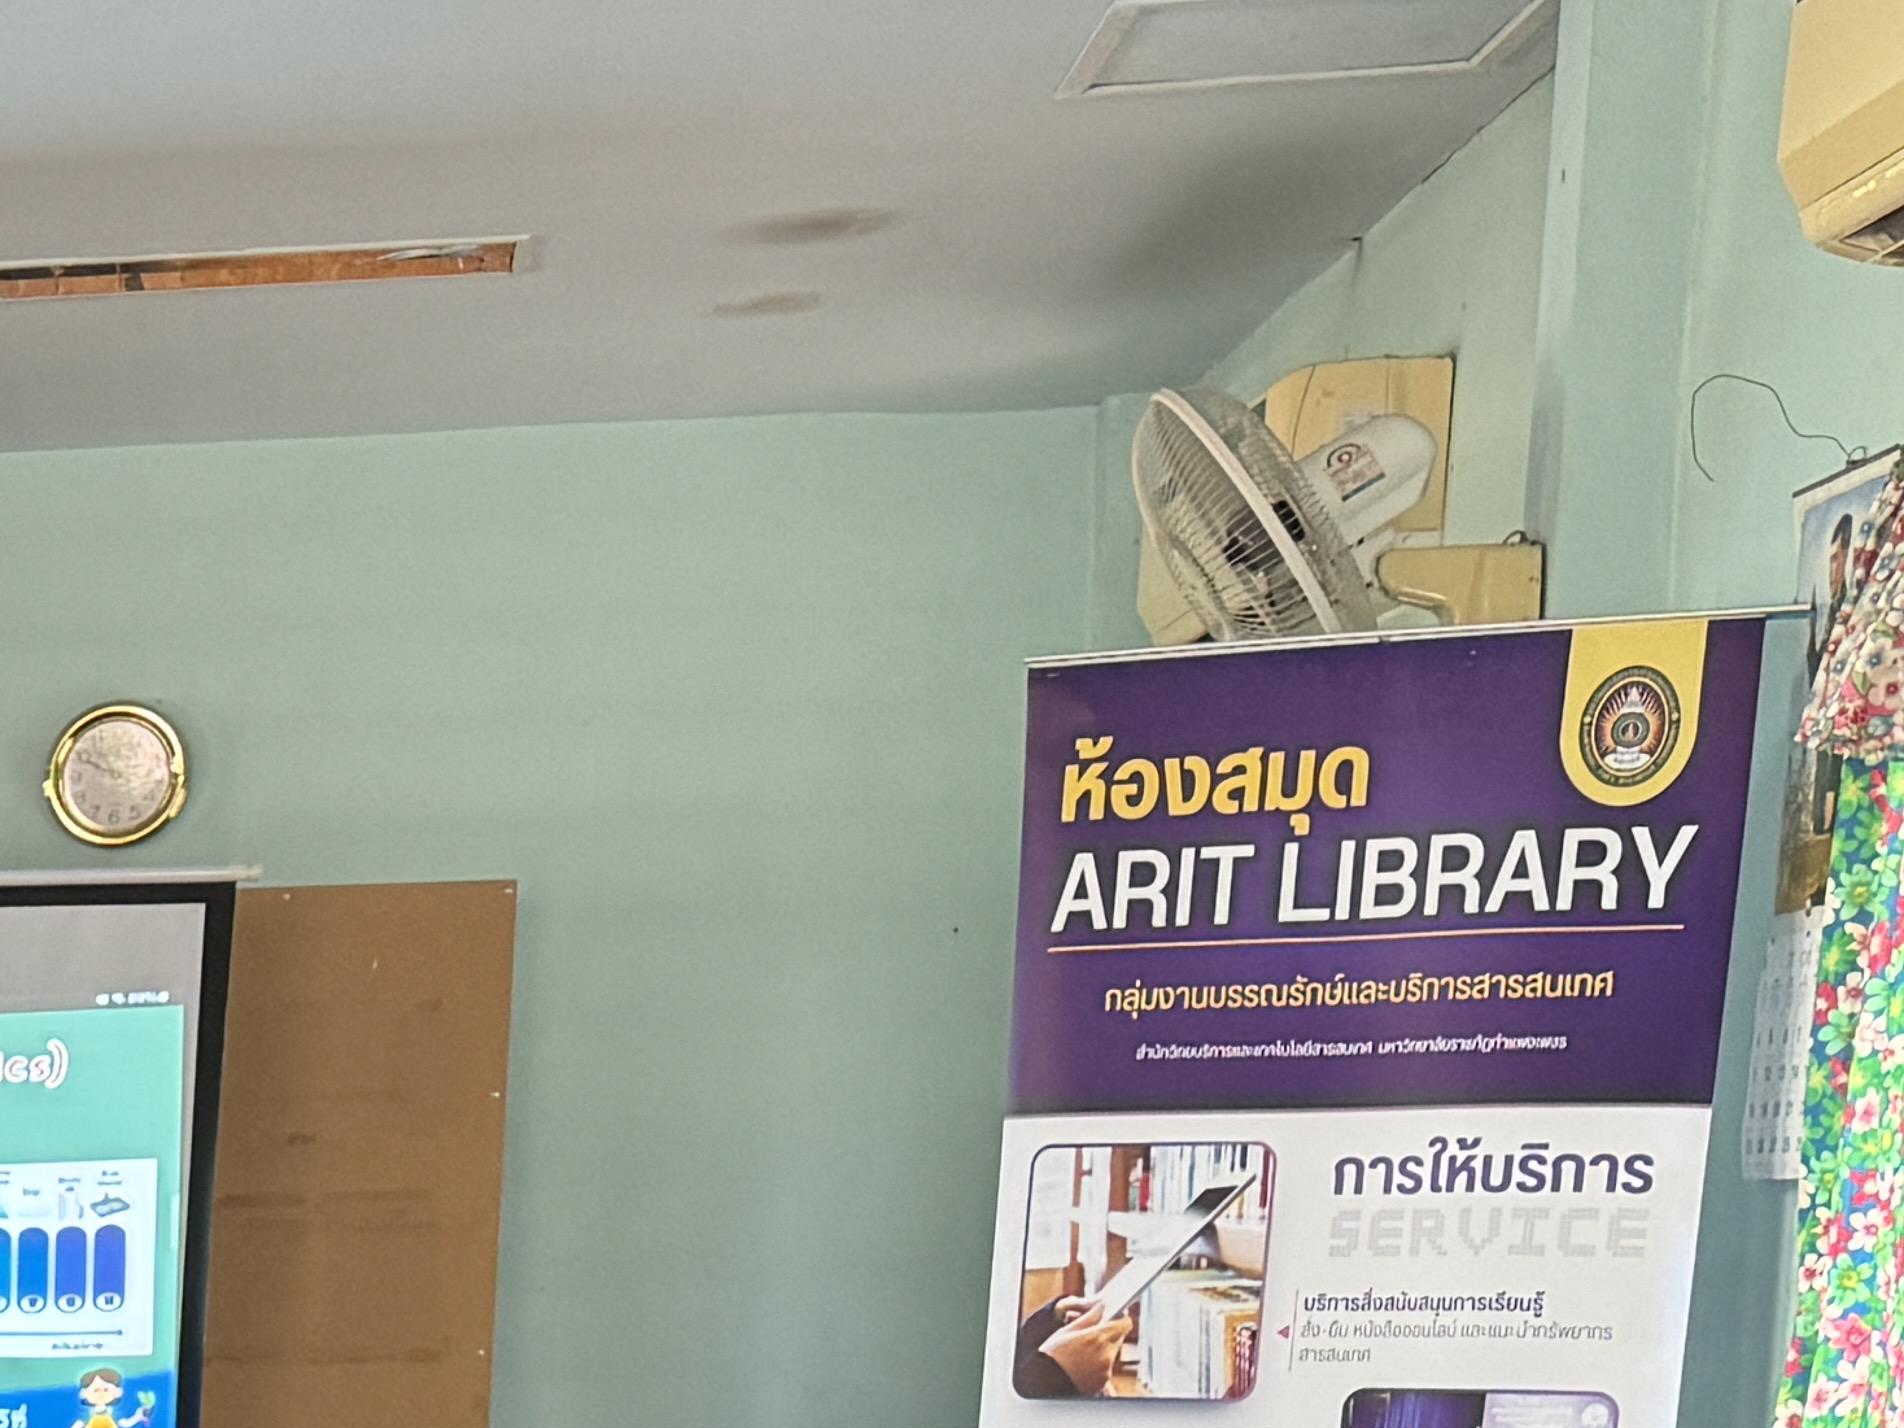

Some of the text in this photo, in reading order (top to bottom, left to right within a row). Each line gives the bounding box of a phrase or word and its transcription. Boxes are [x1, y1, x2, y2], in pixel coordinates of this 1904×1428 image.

[1059, 736, 1371, 835] ห้องสมุด
[1050, 824, 1699, 933] ARIT LIBRARY
[1104, 970, 1614, 1020] กลุ่มงานบรรณรักษ์และบริการสารสนเทศ
[1333, 1136, 1654, 1197] การให้บริการ
[1328, 1207, 1650, 1259] SERVICE
[1304, 1288, 1545, 1318] บริการสิ่งสนับสนุนการเรียนรู้
